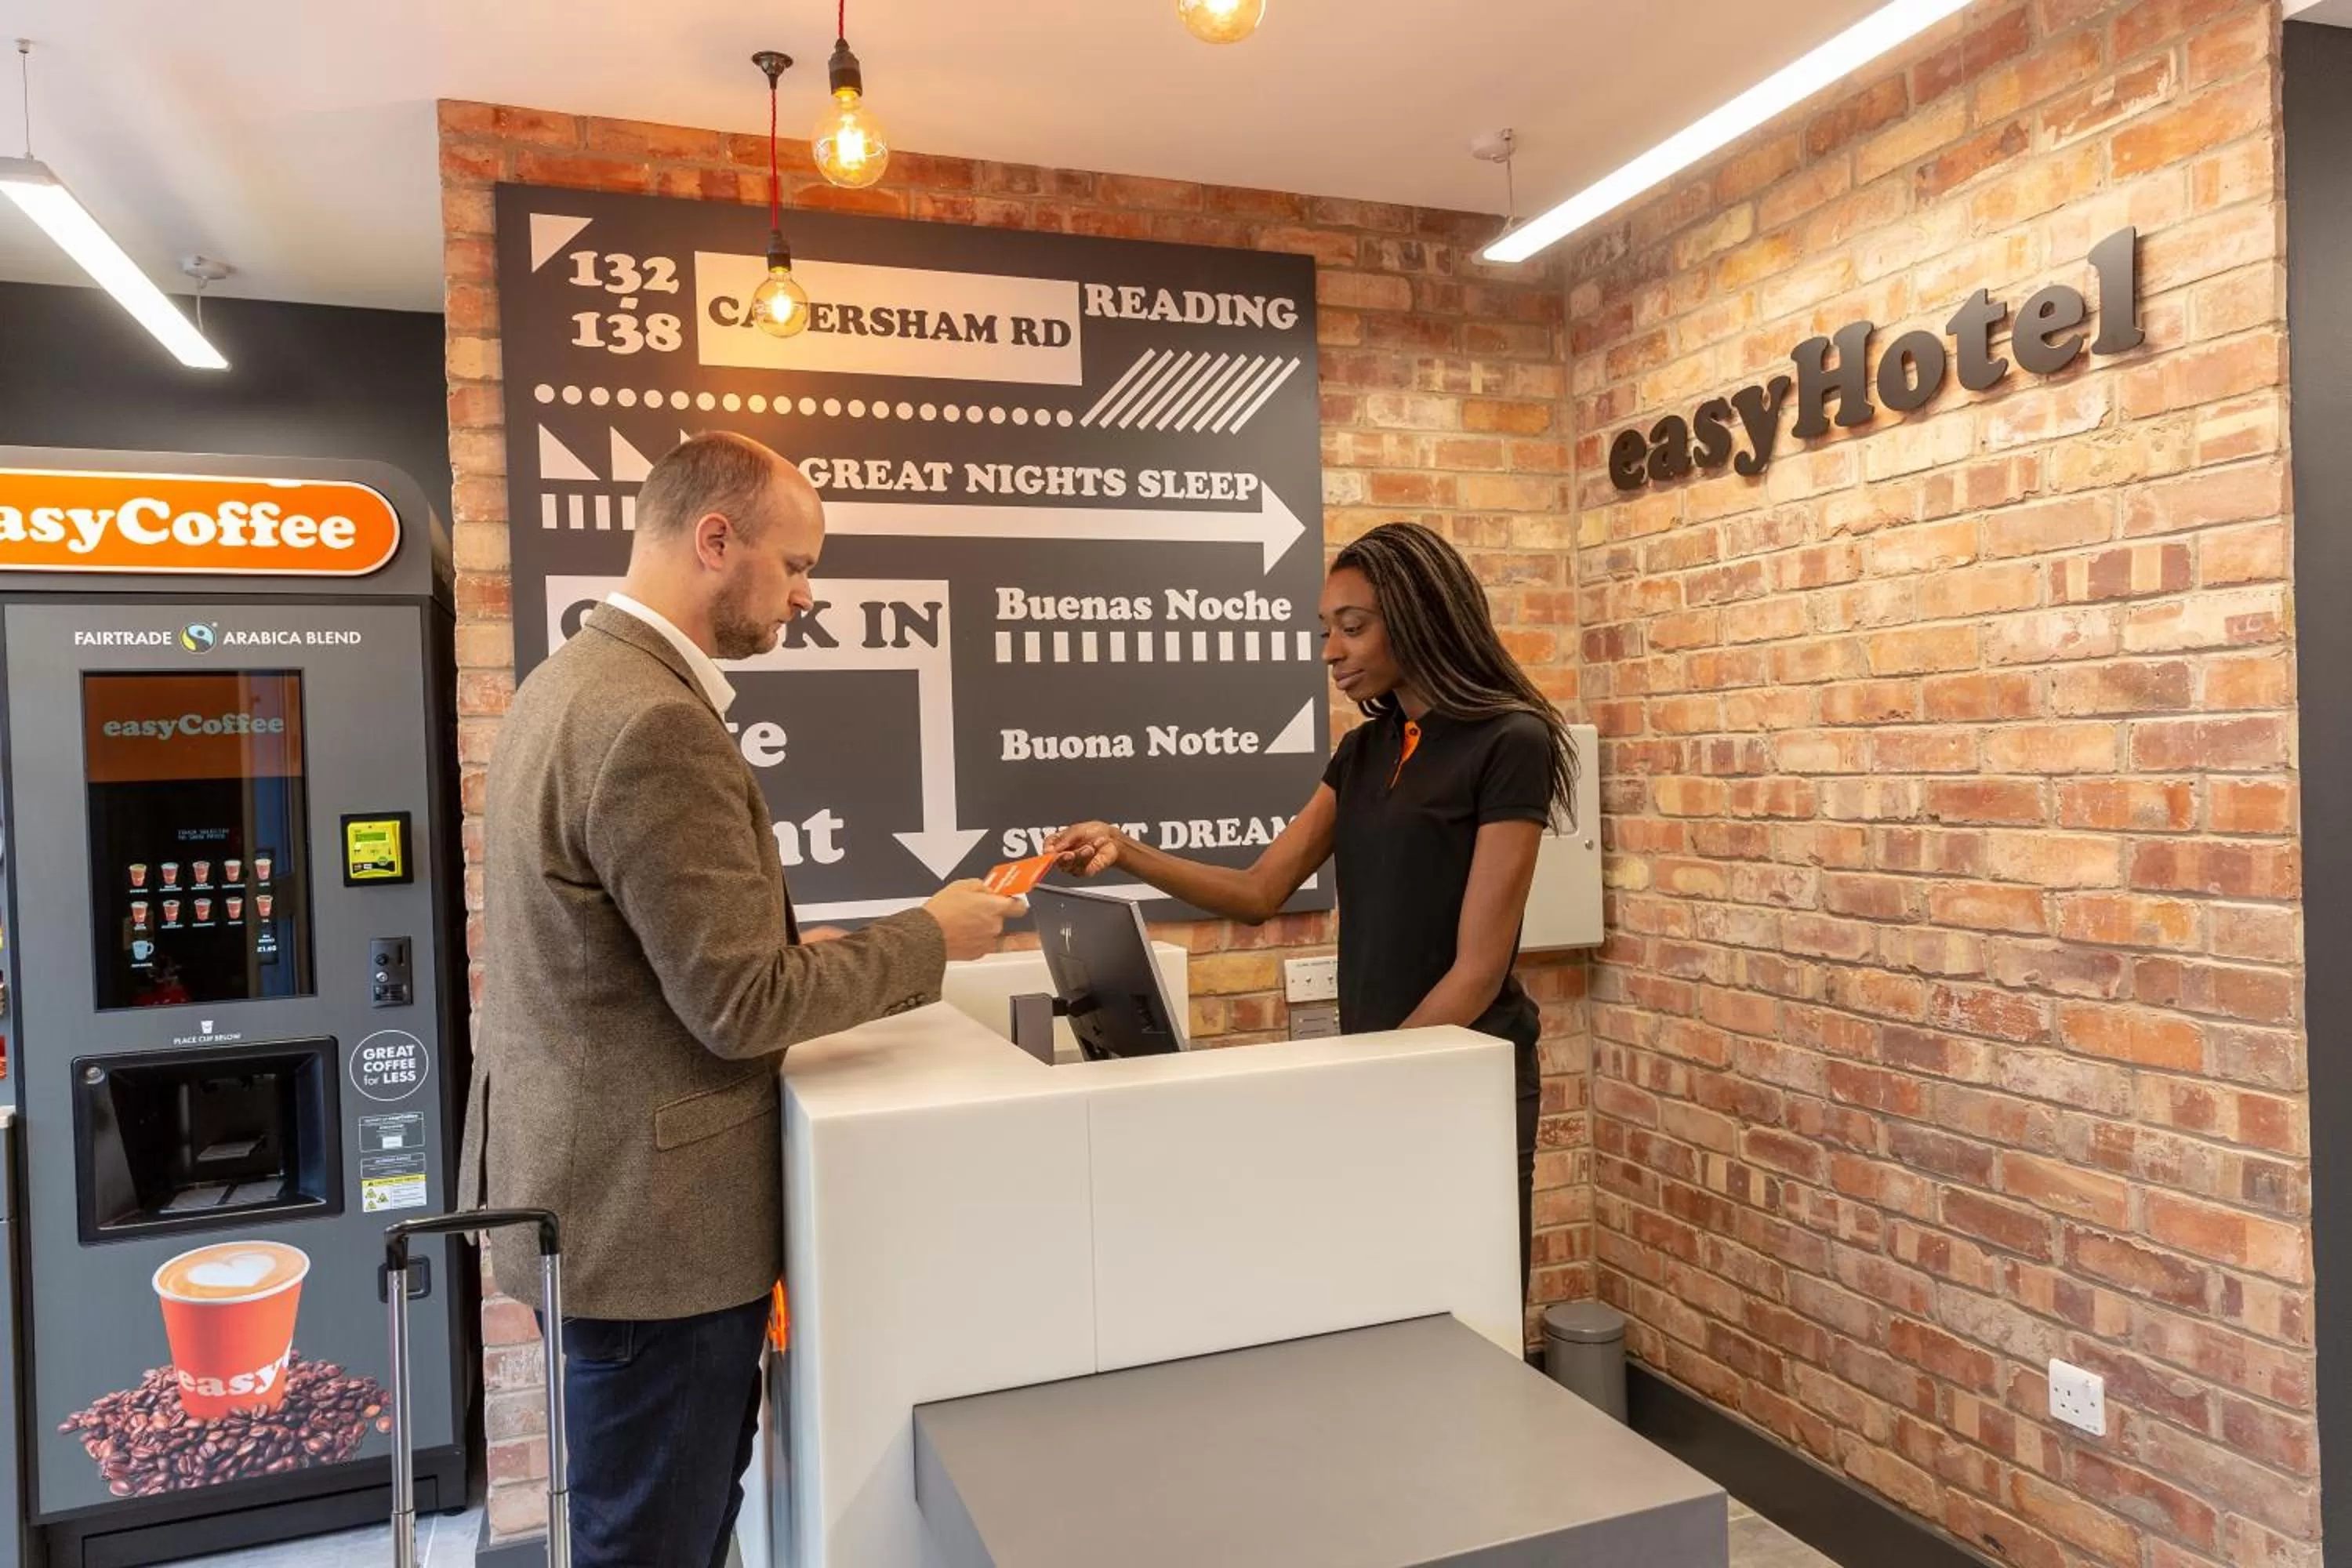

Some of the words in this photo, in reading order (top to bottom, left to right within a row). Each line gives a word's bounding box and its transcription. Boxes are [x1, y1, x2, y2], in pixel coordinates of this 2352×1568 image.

[568, 250, 680, 293] 132
[708, 296, 997, 344] CAERSHAM
[1011, 317, 1072, 347] RD
[1084, 283, 1299, 329] READING
[571, 312, 682, 354] 138
[1608, 226, 2147, 491] easyHotel
[798, 457, 953, 492] GREAT
[965, 463, 1127, 497] NIGHTS
[1138, 470, 1258, 501] SLEEP
[0, 498, 357, 553] asyCoffee
[995, 587, 1152, 621] Buenas
[1164, 589, 1292, 621] Noche
[74, 631, 172, 646] FAIRTRADE
[223, 630, 302, 645] ARABICA
[306, 630, 361, 645] BLEND
[859, 601, 942, 648] IN
[103, 713, 284, 740] easyCoffee
[1000, 728, 1134, 761] Buona
[1146, 724, 1259, 757] Notte
[1003, 822, 1149, 858] SWT
[363, 1045, 415, 1060] GREAT
[363, 1058, 416, 1073] COFFEE
[383, 1070, 416, 1084] LESS
